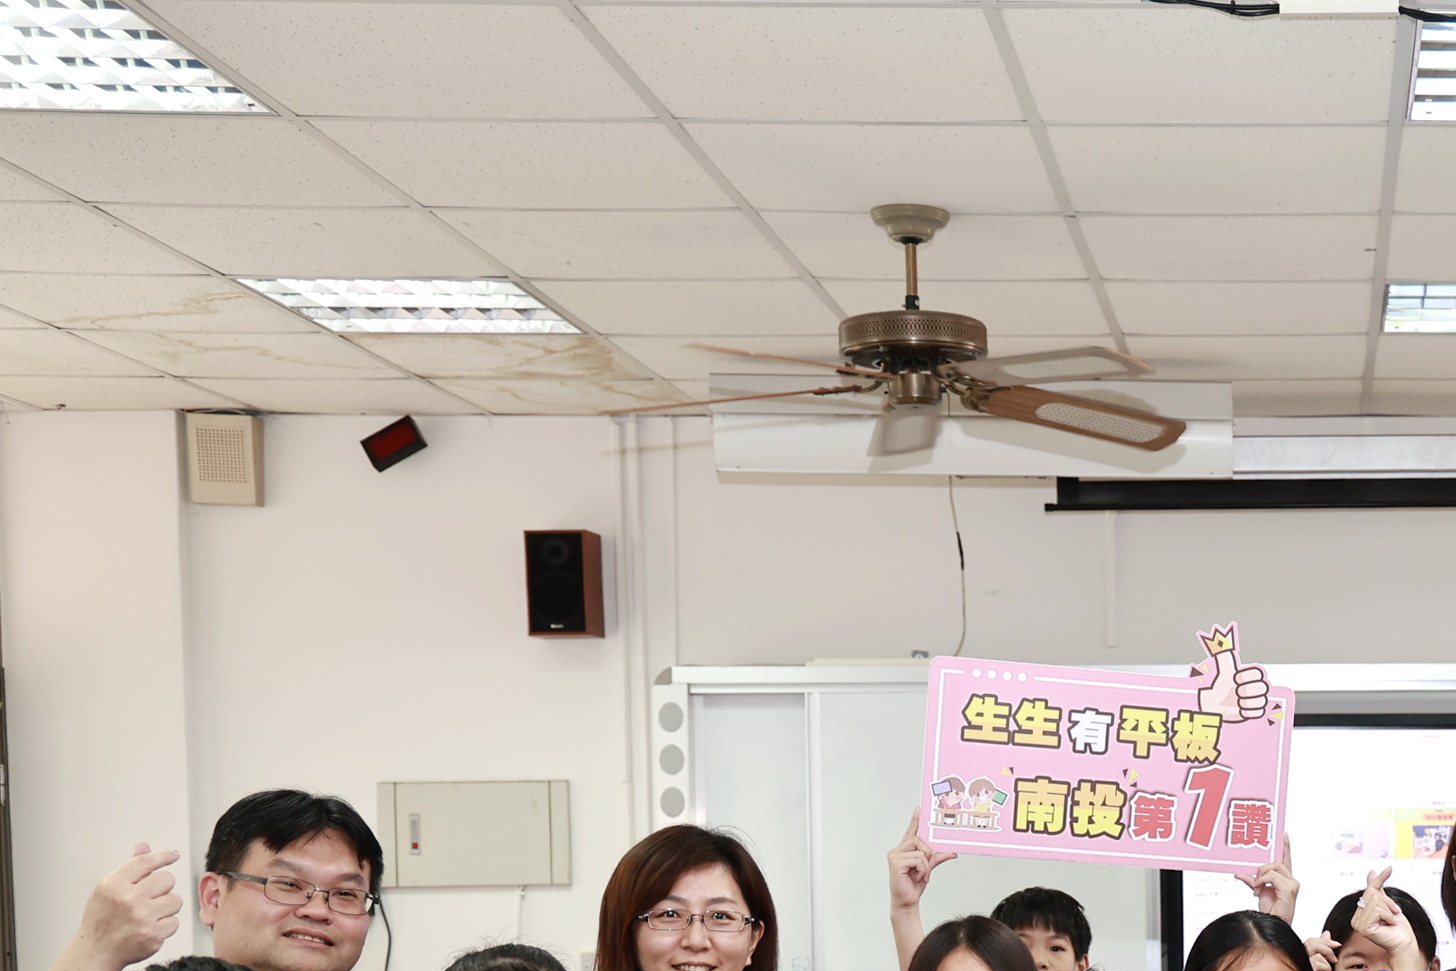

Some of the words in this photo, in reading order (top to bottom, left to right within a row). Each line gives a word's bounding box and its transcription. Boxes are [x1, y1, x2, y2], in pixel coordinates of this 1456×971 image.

[961, 694, 1222, 764] 生生有平板
[1013, 764, 1274, 851] 南投第1讚
